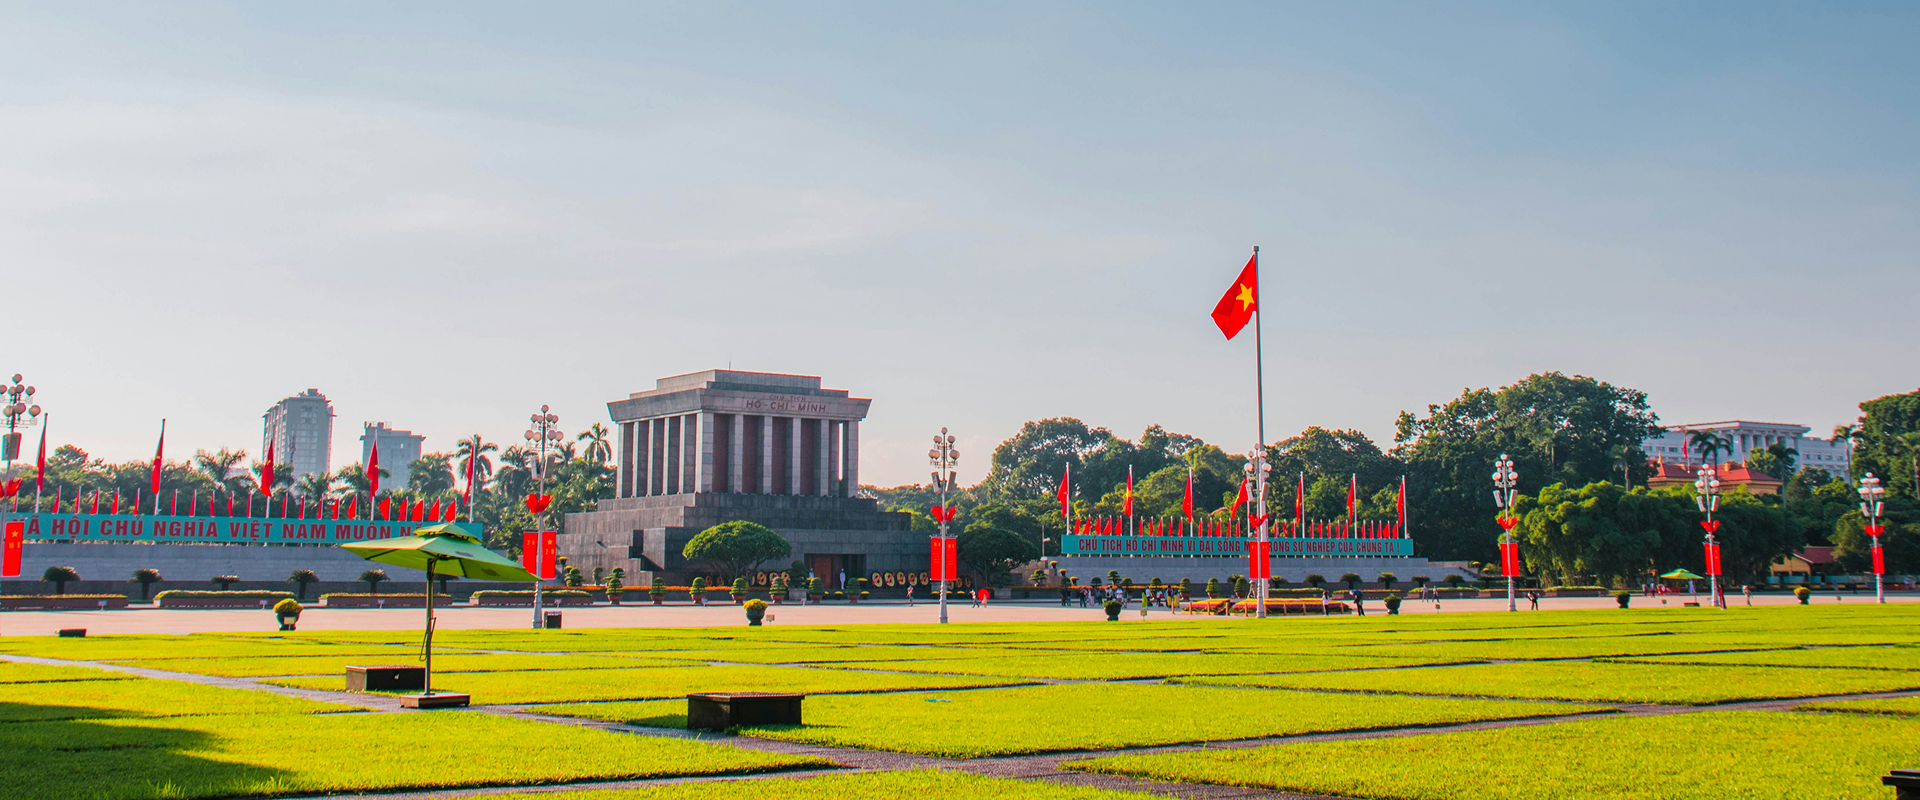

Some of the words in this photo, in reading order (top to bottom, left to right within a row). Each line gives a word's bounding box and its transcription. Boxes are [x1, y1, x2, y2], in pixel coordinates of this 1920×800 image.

[51, 516, 90, 539] HỘI
[100, 515, 144, 537] CHỦ
[153, 518, 218, 538] NGHĨA
[229, 519, 273, 541] VIỆT
[282, 522, 327, 540] NAM
[335, 522, 391, 540] MUÔN
[1078, 535, 1098, 551] CHỦ
[1101, 538, 1122, 553] TỊCH
[1125, 536, 1138, 552] HỒ
[1141, 537, 1157, 552] CHÍ
[1160, 540, 1184, 552] MINH
[1199, 540, 1214, 554] ĐẠI
[1217, 537, 1240, 552] SỐNG
[1268, 540, 1290, 552] RONG
[1306, 539, 1336, 555] NGHIỆP
[1338, 538, 1353, 553] CỦA
[1356, 539, 1382, 553] CHÚNG
[1384, 541, 1395, 553] TA
